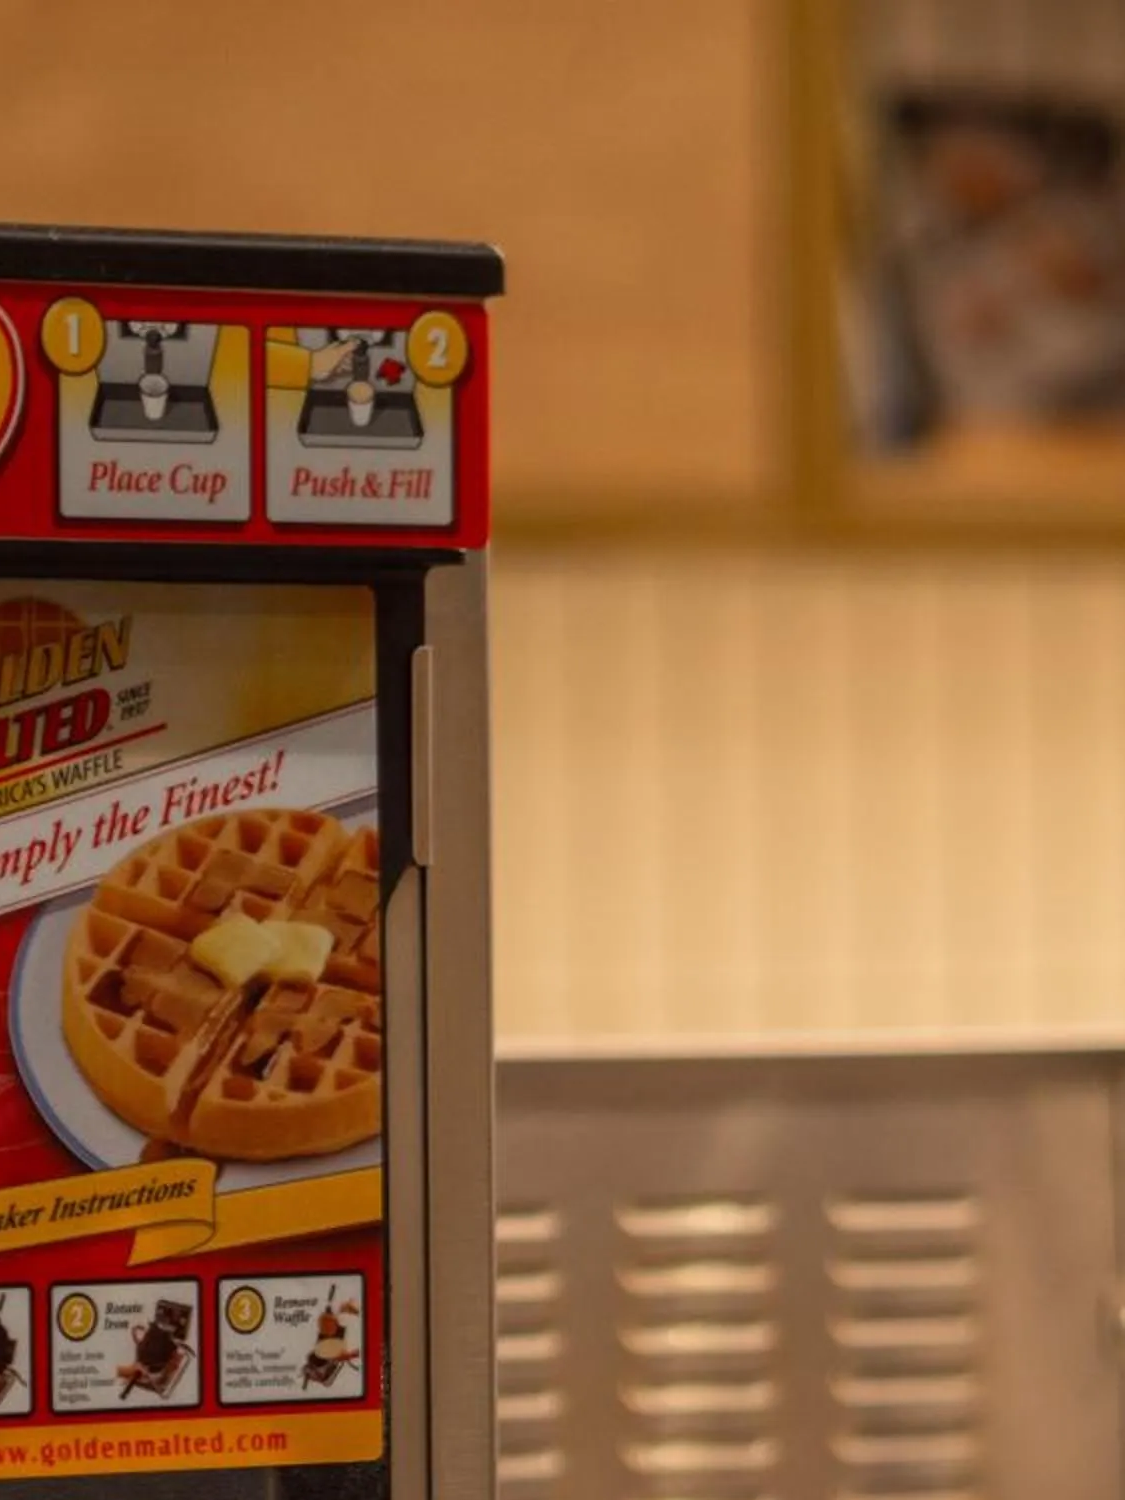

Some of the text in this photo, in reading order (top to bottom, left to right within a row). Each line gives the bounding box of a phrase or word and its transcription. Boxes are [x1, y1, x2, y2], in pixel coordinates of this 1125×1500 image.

[65, 313, 81, 355] 1
[427, 327, 448, 369] 2
[88, 461, 228, 504] Place Cup
[290, 467, 434, 500] Push & Fill
[51, 749, 125, 790] WAFFLE
[90, 800, 151, 851] the
[160, 749, 287, 828] Finest!
[48, 1176, 197, 1223] Instructions
[70, 1303, 86, 1327] 2
